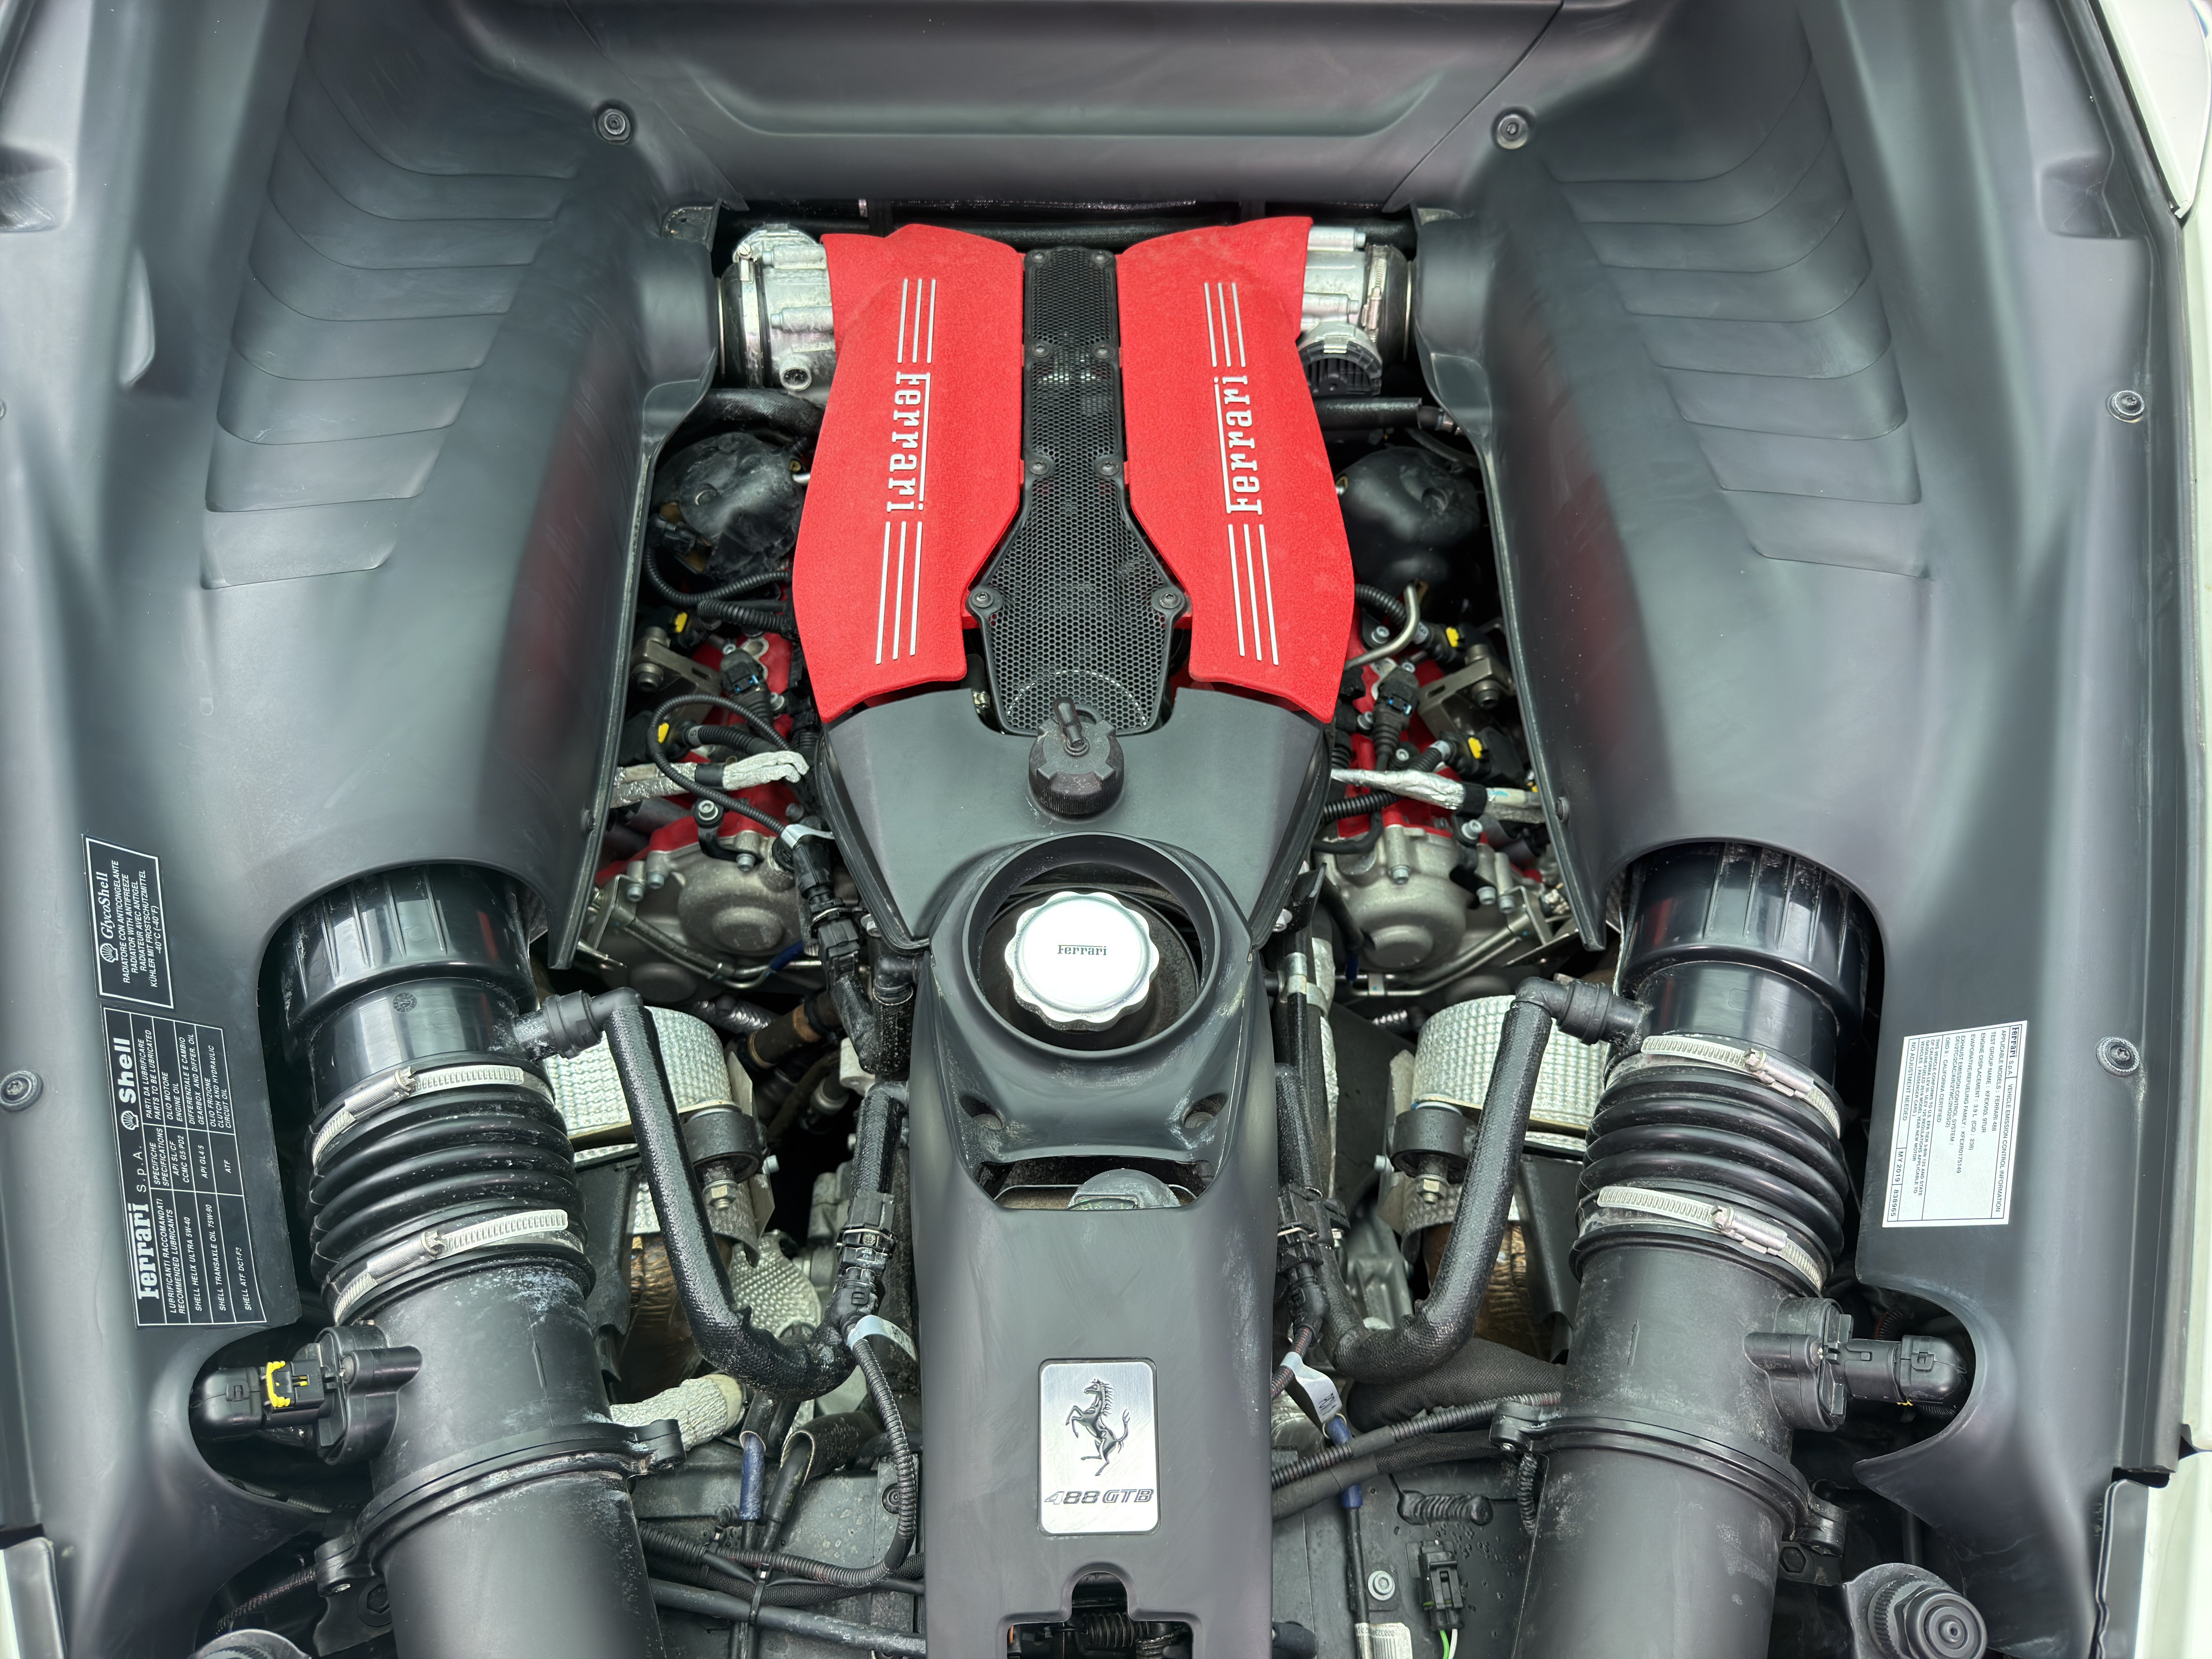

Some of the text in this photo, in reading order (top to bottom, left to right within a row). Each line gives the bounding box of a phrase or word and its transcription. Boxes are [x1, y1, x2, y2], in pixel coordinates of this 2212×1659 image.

[886, 371, 931, 512] Ferrari
[1214, 375, 1263, 515] Ferrari
[96, 871, 115, 939] GlycoShell
[111, 860, 131, 983] RADIATORE CON ANTICONGELANTE
[121, 873, 139, 974] RADIATOR WITH ANTIFREEZE
[131, 881, 147, 972] RADIATEUR AVEC ANTIGEL
[139, 870, 158, 987] KÜHLER MIT FROSTSCHUTZMITTEL
[1058, 945, 1107, 955] Ferrari
[179, 1037, 188, 1064] CAMBIO
[189, 1047, 198, 1072] DIFFER.
[1911, 1042, 1916, 1051] NO
[1921, 1040, 1930, 1084] GASOLINE-FUELED
[1998, 1030, 2007, 1064] APPLICABLE
[2009, 1026, 2020, 1058] Ferrari
[113, 1037, 136, 1104] Shell
[137, 1038, 153, 1119] PARTI DA LUBRIFICARE
[145, 1030, 162, 1120] PARTS TO BE LUBRICATED
[192, 1073, 200, 1088] AND
[208, 1045, 219, 1083] HYDRAULIC
[1906, 1053, 1915, 1093] ADJUSTMENT
[1940, 1060, 1948, 1093] CALIFORNIA
[1964, 1034, 1976, 1104] EVAPORATIVE/REFUELING
[1974, 1055, 1984, 1098] DISPLACEMENT
[161, 1071, 174, 1120] OLIO MOTORE
[174, 1095, 183, 1122] ENGINE
[183, 1071, 195, 1125] DIFFERENZIALE
[194, 1091, 205, 1125] GEARBOX
[204, 1077, 214, 1109] FRIZIONE
[215, 1101, 224, 1128] CLUTCH
[222, 1101, 232, 1128] CIRCUIT
[1918, 1118, 1926, 1153] REGULATIONS
[149, 1142, 161, 1185] SPECIFICHE
[156, 1128, 169, 1187] SPECIFICATIONS
[169, 1141, 178, 1162] SL/CF
[177, 1135, 190, 1183] CCMC G5/PD2
[198, 1145, 208, 1179] API GL4/5
[1897, 1151, 1904, 1162] MY
[1956, 1131, 1965, 1174] KFEXR0175149
[2000, 1140, 2008, 1169] CONTROL
[1891, 1189, 1899, 1217] 838965
[1995, 1170, 2005, 1212] INFORMATION
[205, 1204, 215, 1228] 75W-90
[127, 1203, 160, 1299] Ferrari
[156, 1198, 177, 1313] LUBRIFICANTI RACCOMANDATI
[166, 1209, 186, 1314] RECOMMENDED LUBRICANTS
[184, 1217, 202, 1311] SHELL HELIX ULTRA 5W-40
[210, 1243, 222, 1285] TRANSAXLE
[217, 1288, 226, 1311] SHELL
[235, 1247, 252, 1311] SHELL ATF DCT-F3
[1044, 1489, 1154, 1505] 488 GTB
